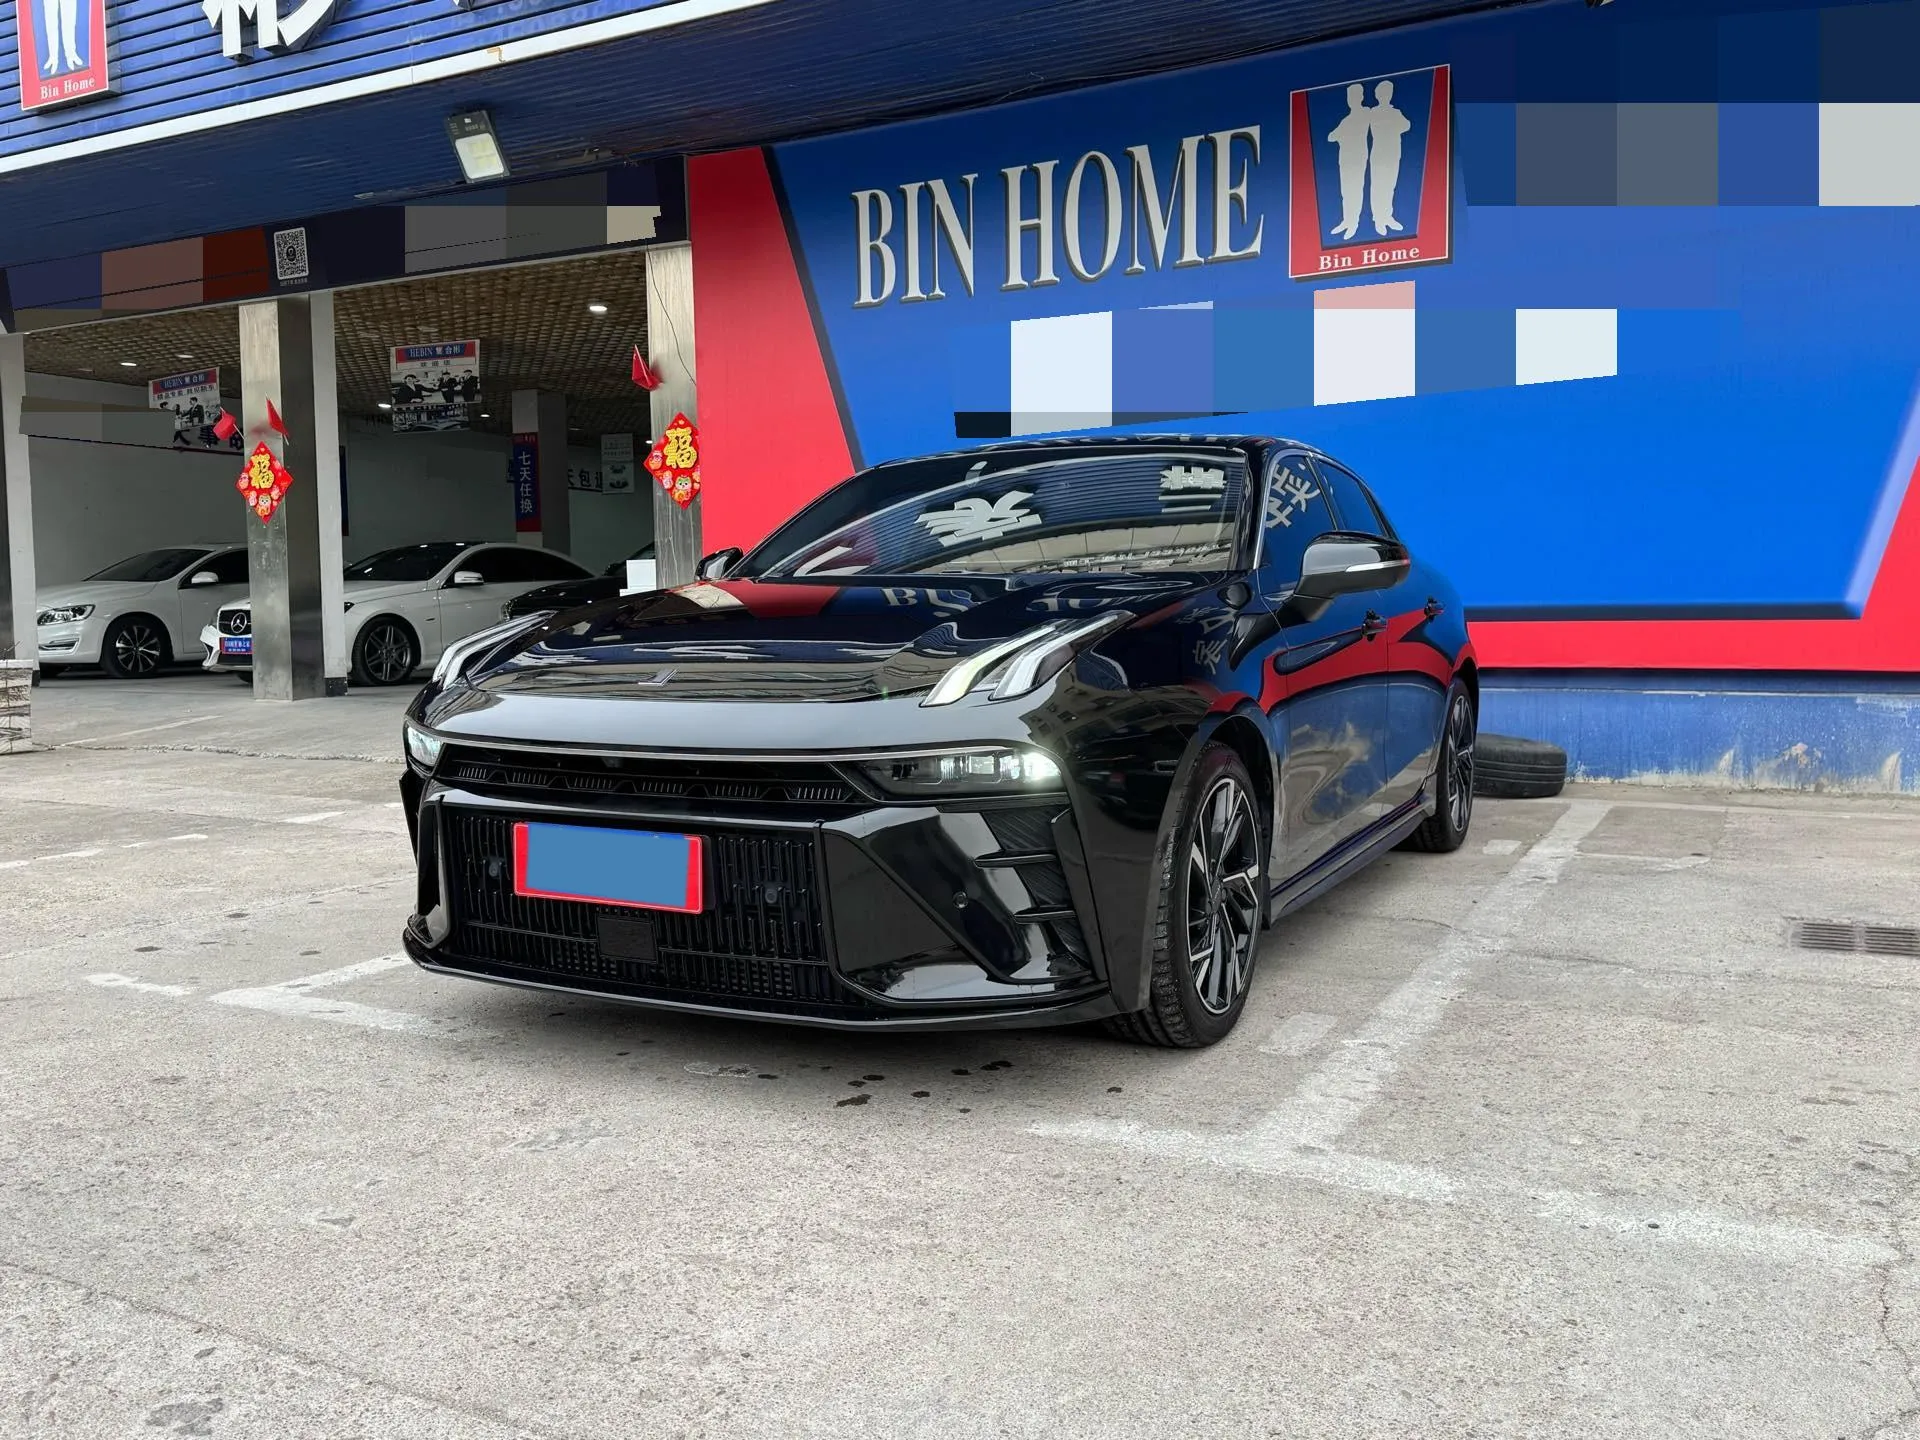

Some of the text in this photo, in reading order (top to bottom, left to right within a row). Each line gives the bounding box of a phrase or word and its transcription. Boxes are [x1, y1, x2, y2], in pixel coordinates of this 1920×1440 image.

[40, 78, 95, 99] Bin Home
[851, 125, 1265, 308] BIN HOME
[1319, 246, 1420, 271] Bin Home
[410, 346, 433, 357] HEBIN
[663, 427, 698, 469] 福
[249, 453, 275, 489] 福
[518, 451, 533, 513] 七天任换
